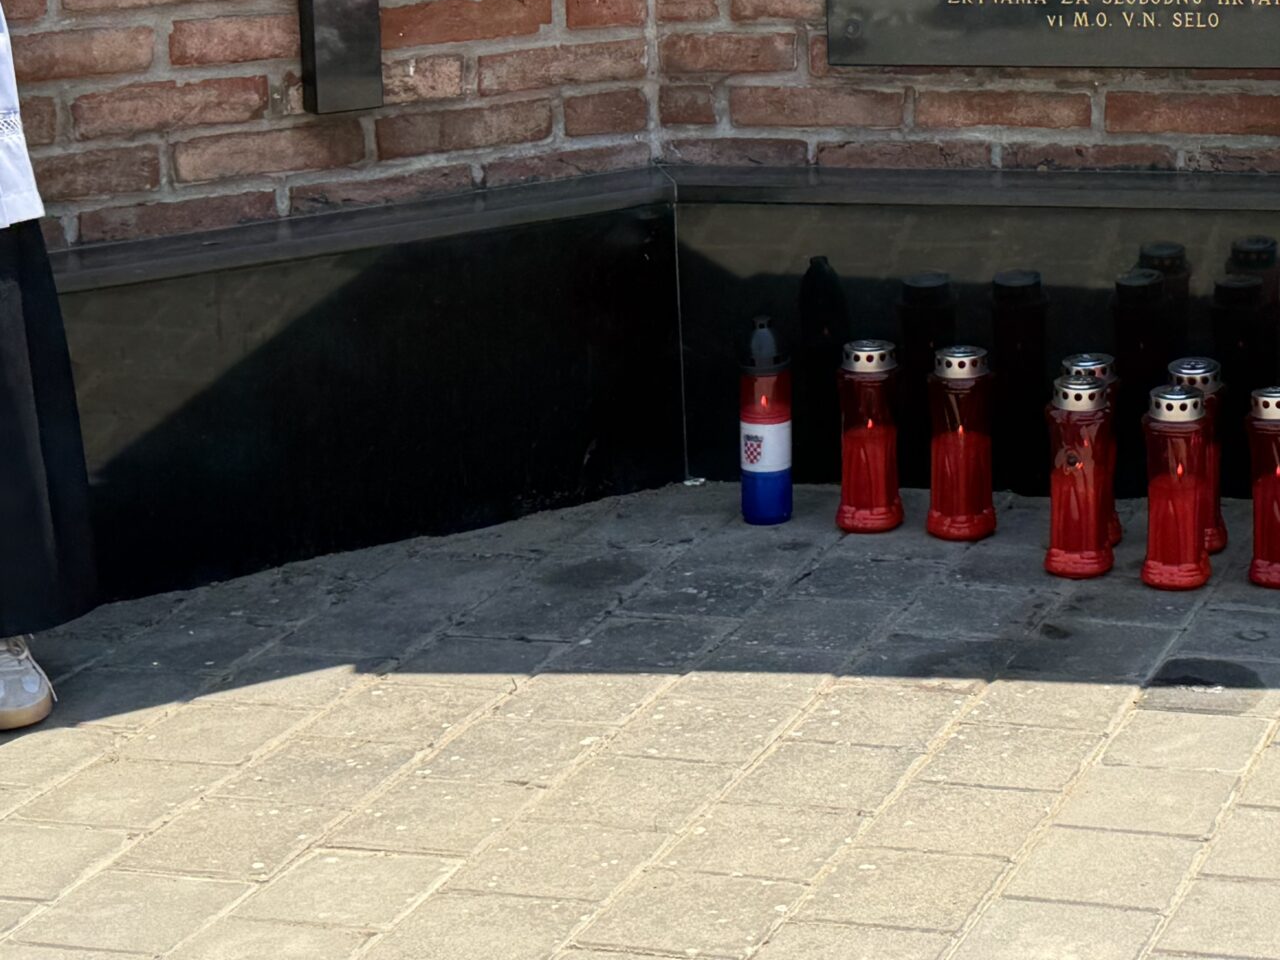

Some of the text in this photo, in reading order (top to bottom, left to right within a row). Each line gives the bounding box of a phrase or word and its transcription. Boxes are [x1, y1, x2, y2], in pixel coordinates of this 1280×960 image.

[1073, 12, 1112, 27] M.O.
[1122, 12, 1161, 27] V.N.
[1173, 12, 1219, 27] SELO
